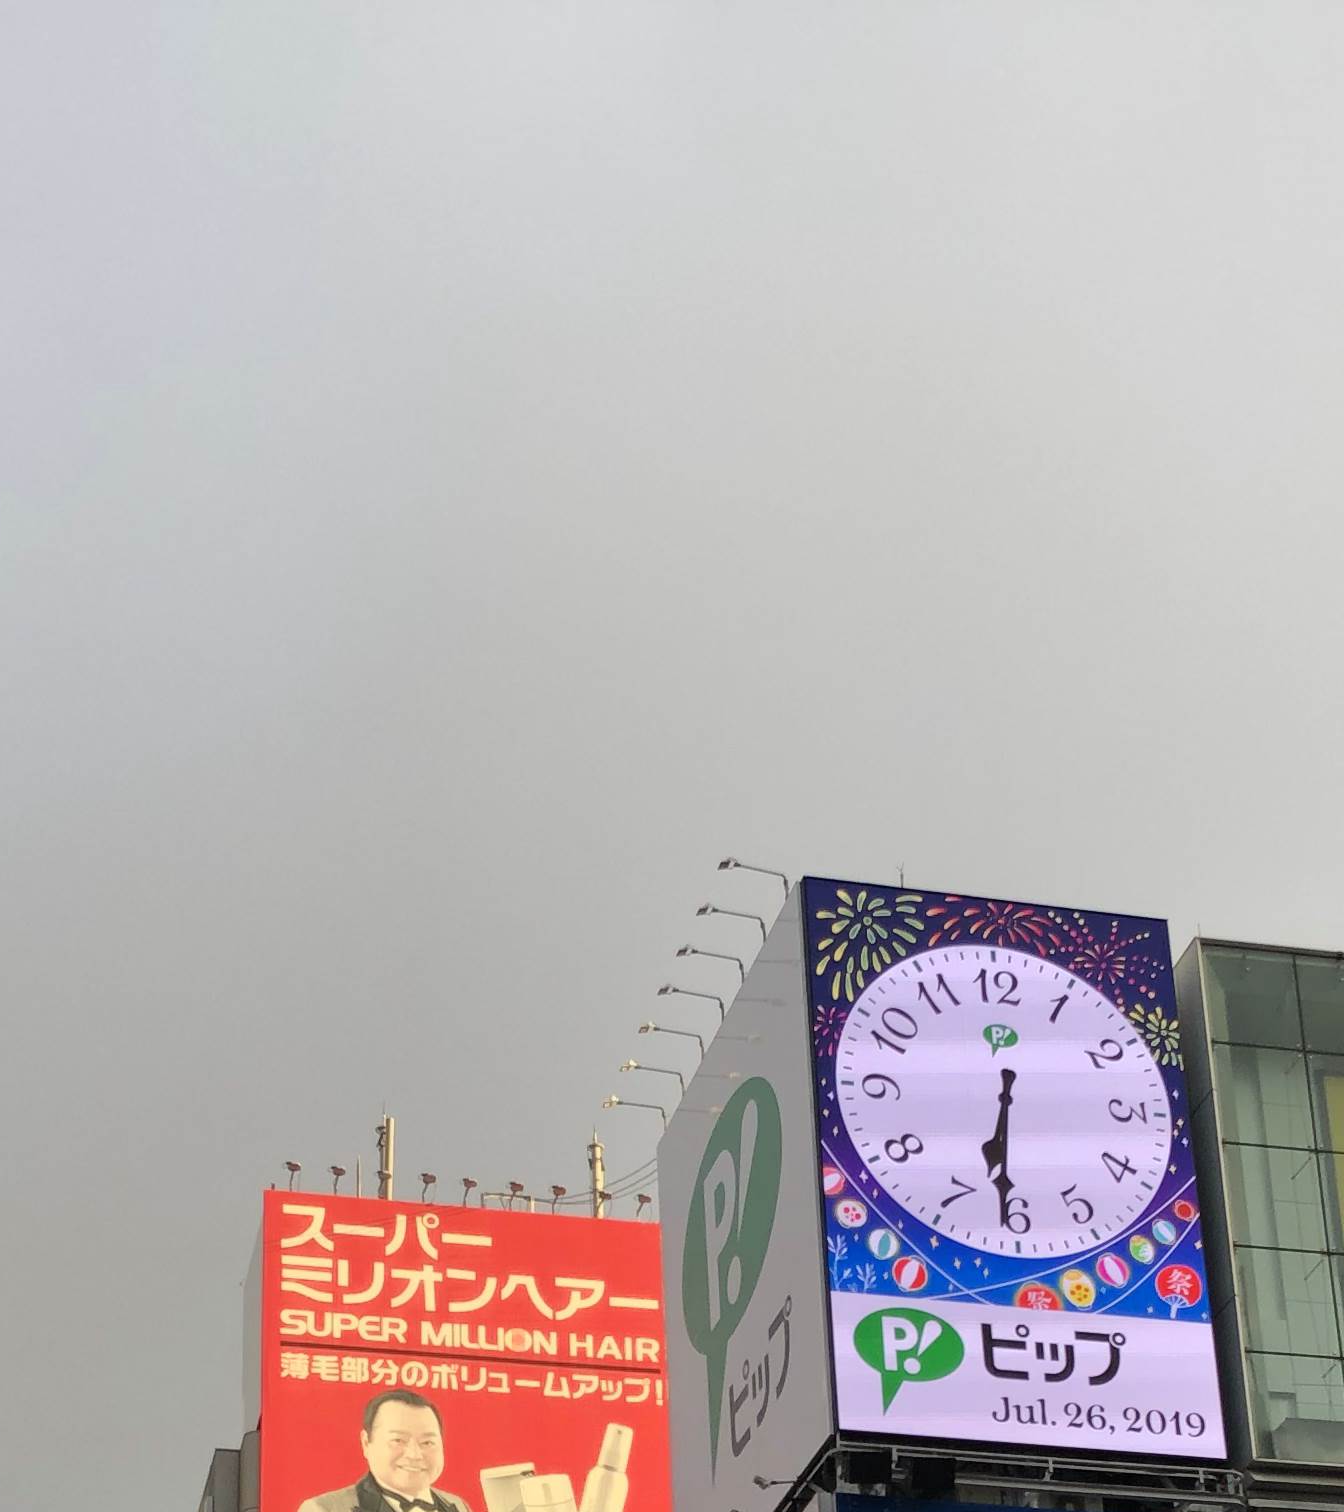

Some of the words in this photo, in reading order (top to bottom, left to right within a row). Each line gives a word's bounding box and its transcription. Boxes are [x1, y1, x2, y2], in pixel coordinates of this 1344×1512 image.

[917, 972, 962, 1016] 11
[973, 967, 1023, 1008] 12
[1049, 993, 1070, 1024] 1
[869, 1006, 920, 1056] 10
[1085, 1037, 1125, 1071] 2
[861, 1072, 902, 1102] 9
[1108, 1099, 1148, 1125] 3
[884, 1132, 925, 1164] 8
[1100, 1151, 1138, 1184] 4
[939, 1175, 977, 1210] 7
[1059, 1183, 1095, 1226] 5
[280, 1203, 493, 1262] スーパー
[1005, 1196, 1032, 1235] 6
[280, 1254, 659, 1321] ミリオンヘアー
[279, 1309, 407, 1344] SUPER
[420, 1321, 558, 1356] MILLION
[568, 1333, 661, 1363] HAIR
[980, 1322, 1127, 1386] ピップ
[728, 1294, 792, 1459] ピップ
[991, 1396, 1058, 1428] Jul.
[1066, 1400, 1116, 1435] 26,
[1121, 1407, 1207, 1439] 2019
